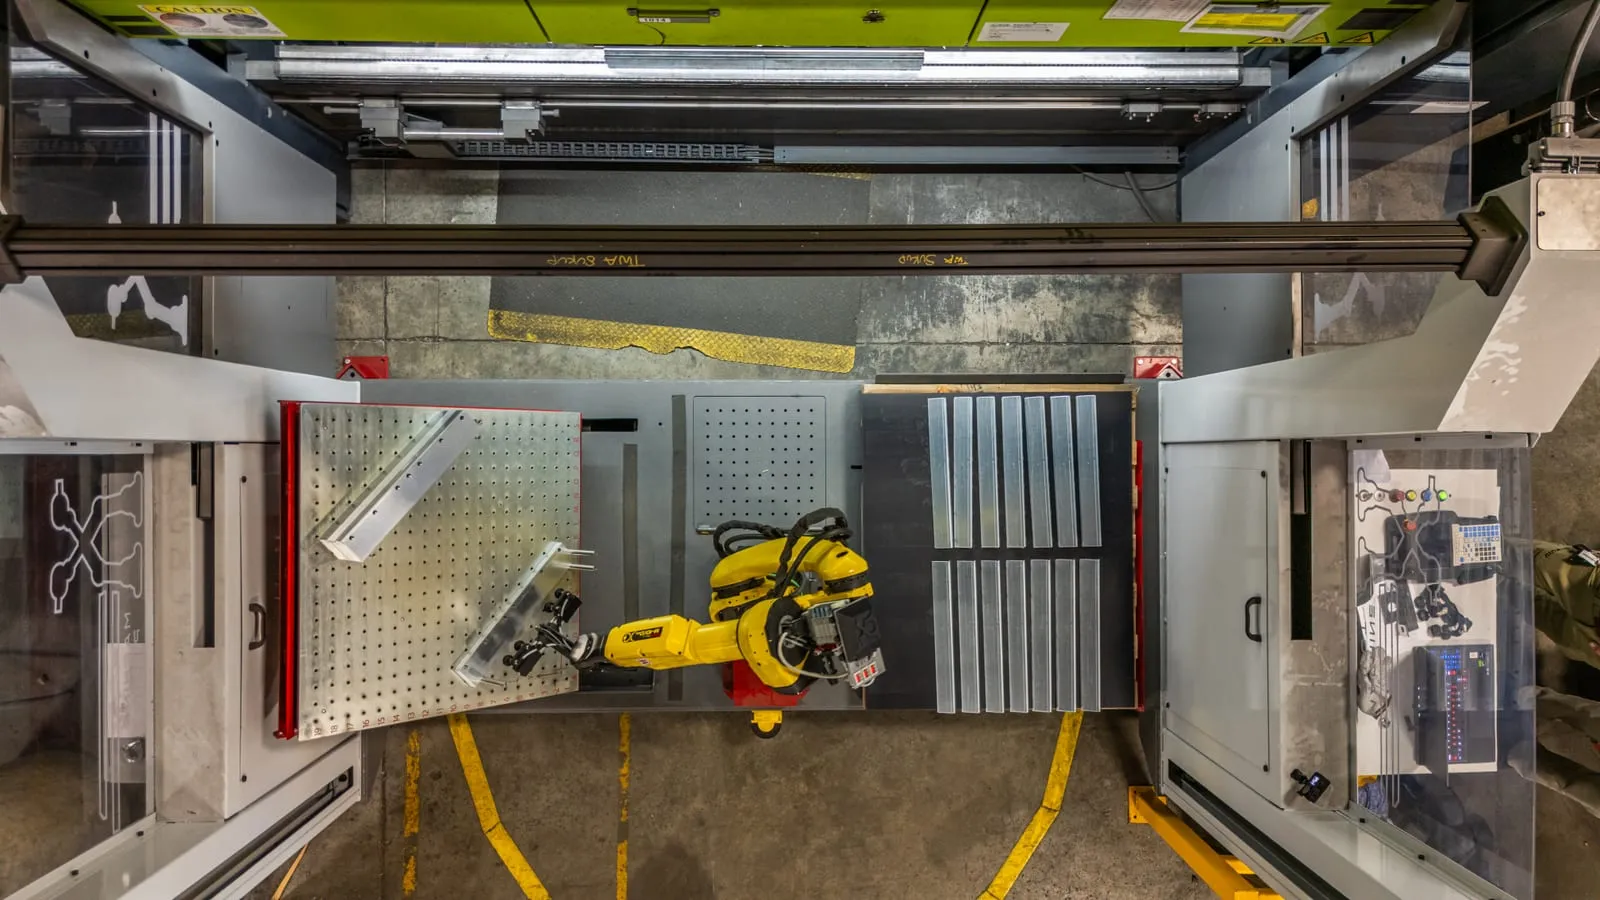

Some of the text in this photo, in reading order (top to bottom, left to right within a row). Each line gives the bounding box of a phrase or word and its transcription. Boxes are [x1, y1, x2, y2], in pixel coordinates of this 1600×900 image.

[156, 6, 246, 14] CAUTION
[603, 254, 646, 267] TWA
[314, 727, 322, 736] 19
[330, 724, 338, 733] 18
[362, 719, 370, 728] 16
[377, 717, 385, 725] 15
[392, 714, 400, 722] 14
